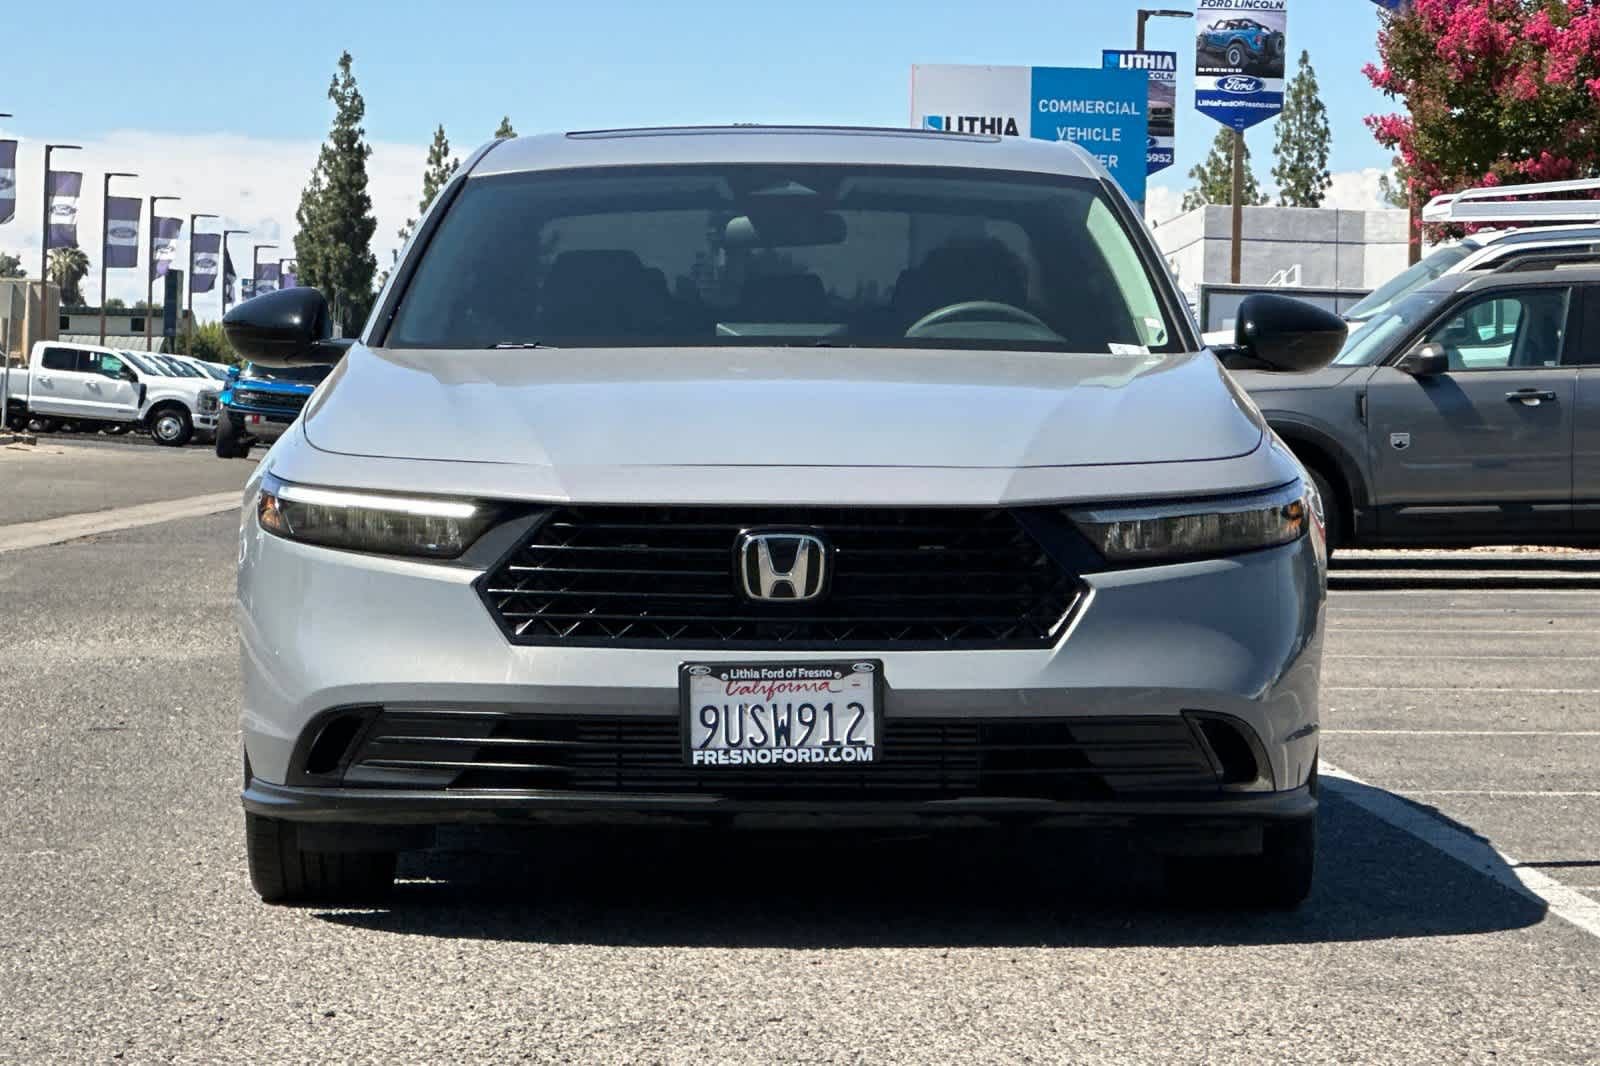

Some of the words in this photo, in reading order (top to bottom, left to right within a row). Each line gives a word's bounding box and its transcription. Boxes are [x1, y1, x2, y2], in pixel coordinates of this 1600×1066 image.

[1201, 0, 1233, 8] FORD
[1234, 0, 1284, 9] LINCOLN
[1119, 54, 1175, 70] LITHIA
[1223, 77, 1256, 91] Ford
[1038, 99, 1141, 116] COMMERCIAL
[945, 115, 1020, 137] LITHIA
[1056, 126, 1122, 142] VEHICLE
[729, 668, 760, 680] Lithia
[761, 668, 785, 679] Ford
[785, 667, 797, 679] of
[798, 667, 833, 679] Fresno
[725, 679, 843, 702] California
[699, 702, 867, 749] 9USW912
[692, 747, 874, 765] FRESNOFORD.COM
